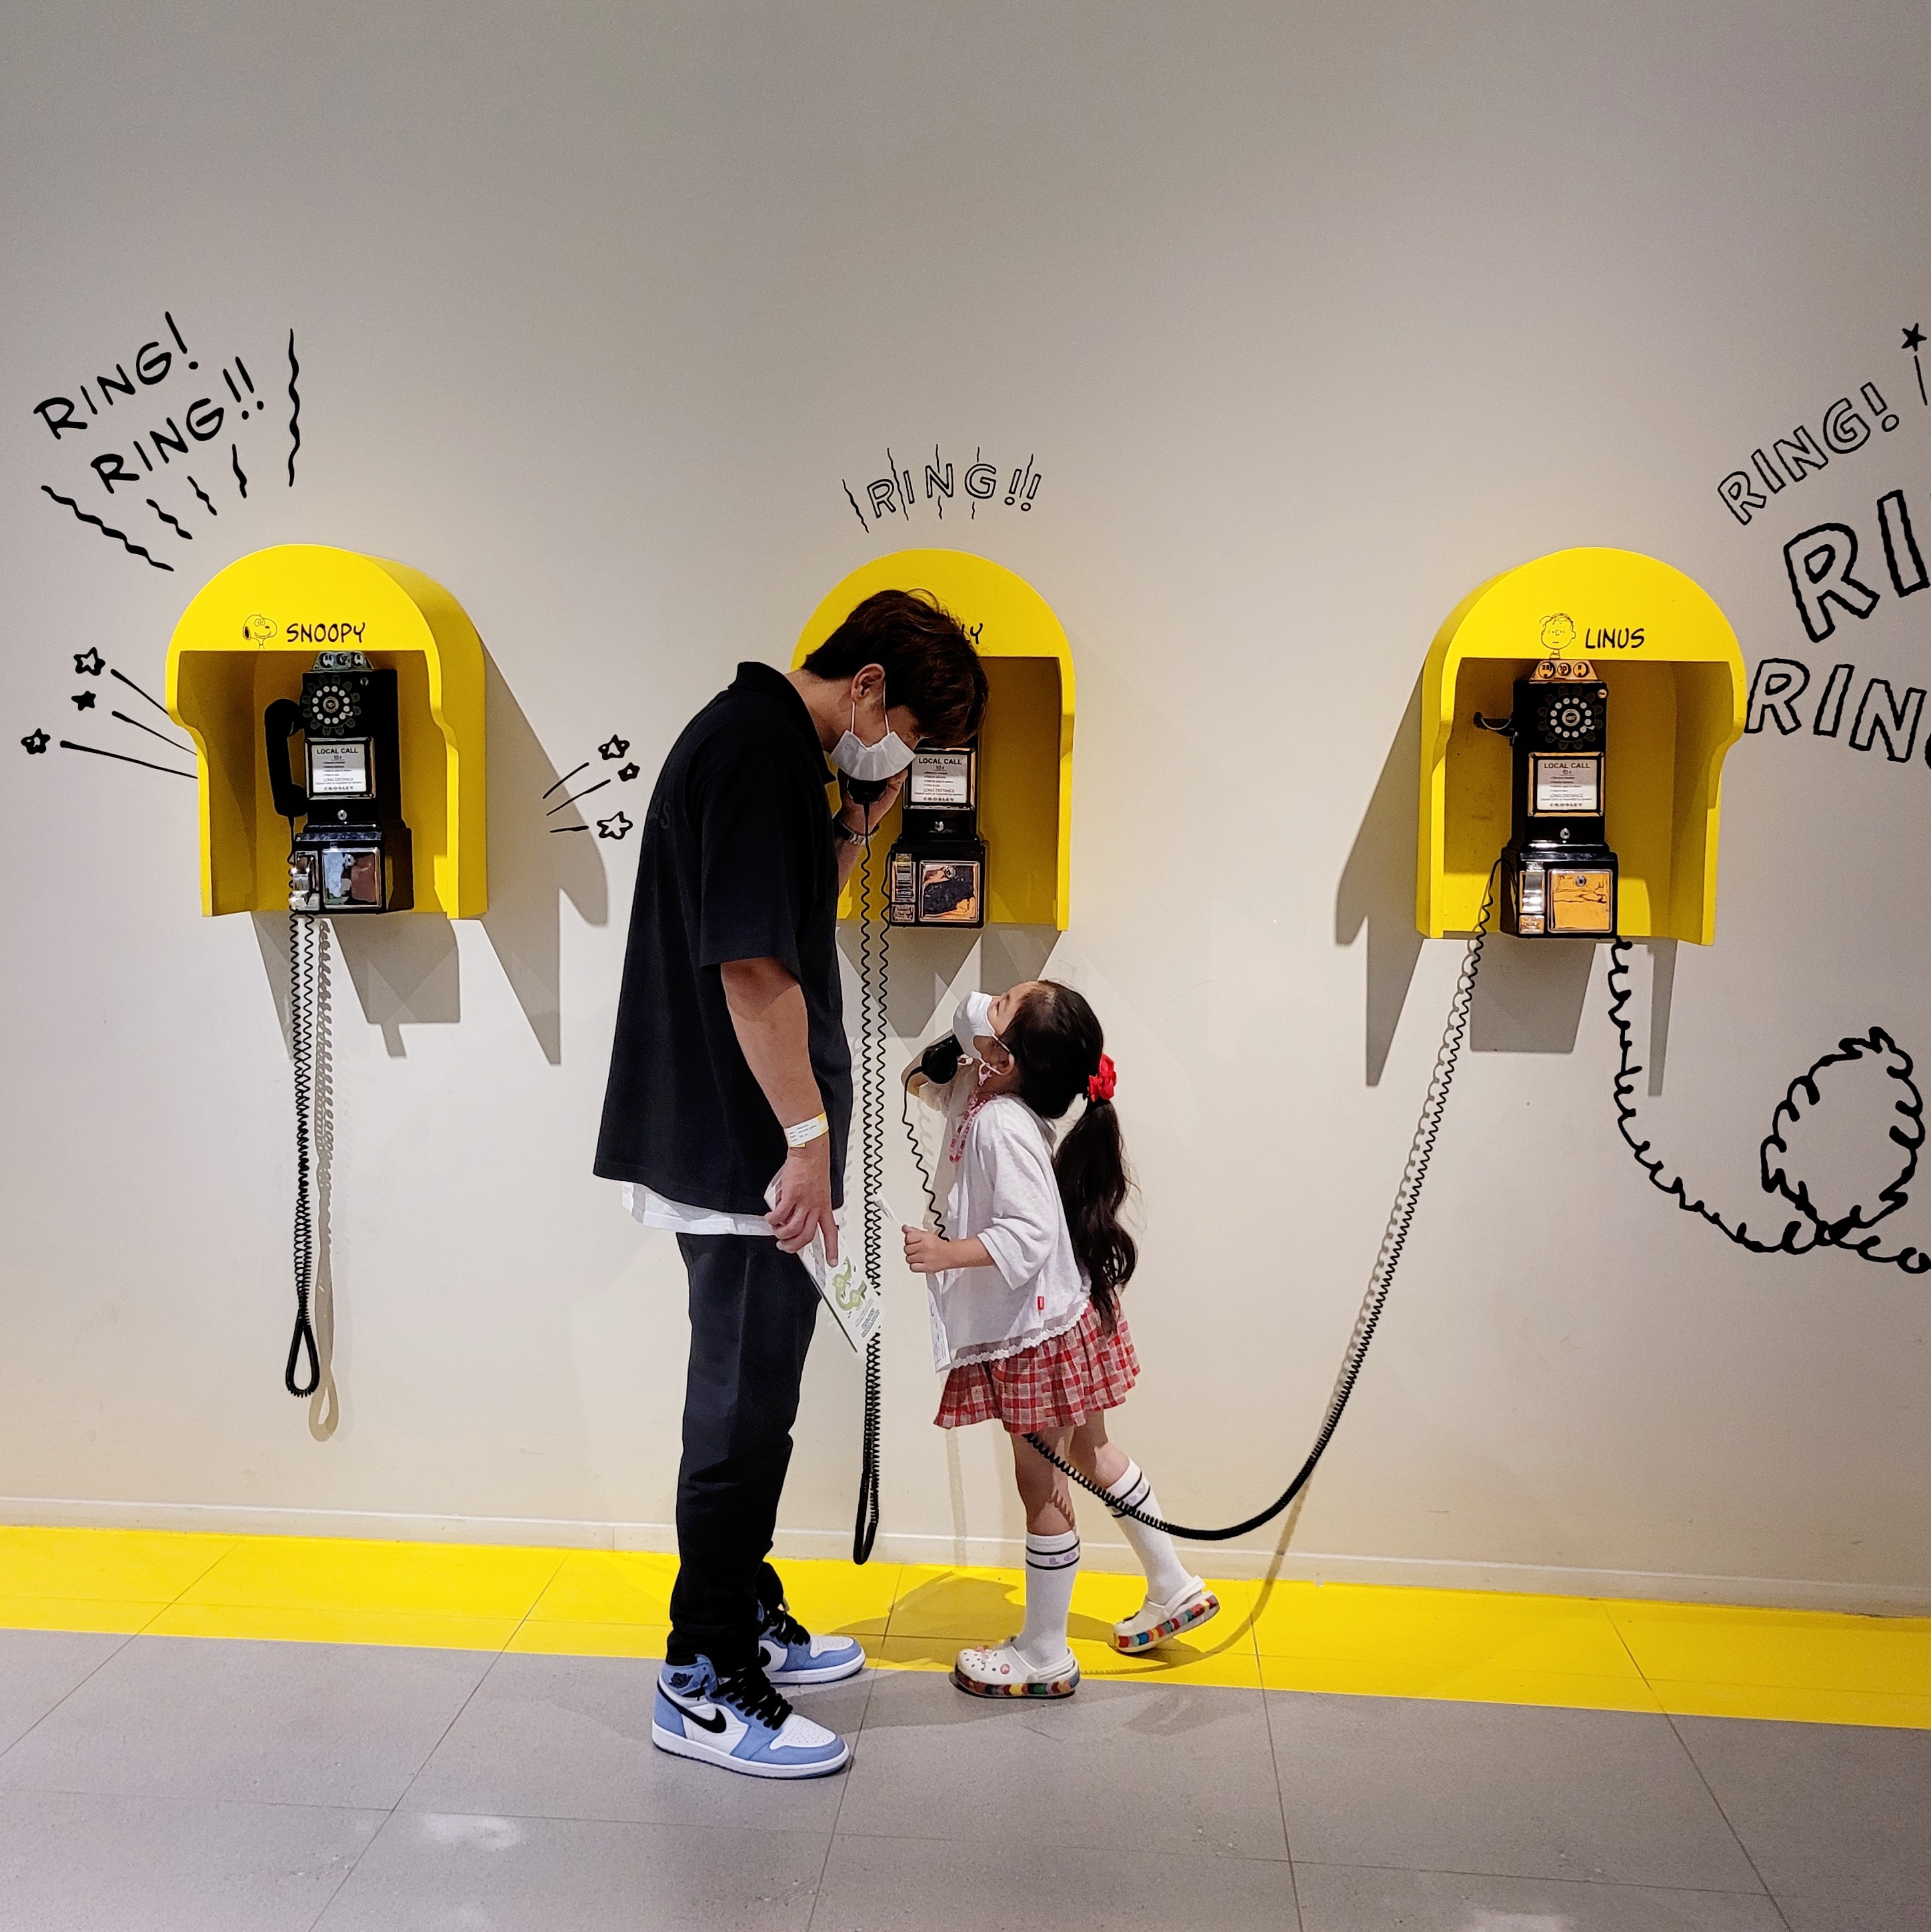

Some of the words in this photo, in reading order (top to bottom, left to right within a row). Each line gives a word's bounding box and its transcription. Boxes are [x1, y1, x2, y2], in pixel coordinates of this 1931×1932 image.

[33, 311, 199, 440] RING!
[90, 356, 264, 494] RING!!
[866, 463, 1042, 519] RING!!
[1717, 381, 1900, 526] RING!
[1783, 489, 1931, 644] RI
[286, 622, 365, 644] SNOOPY
[1585, 628, 1645, 649] LINUS
[1743, 658, 1931, 770] RIN
